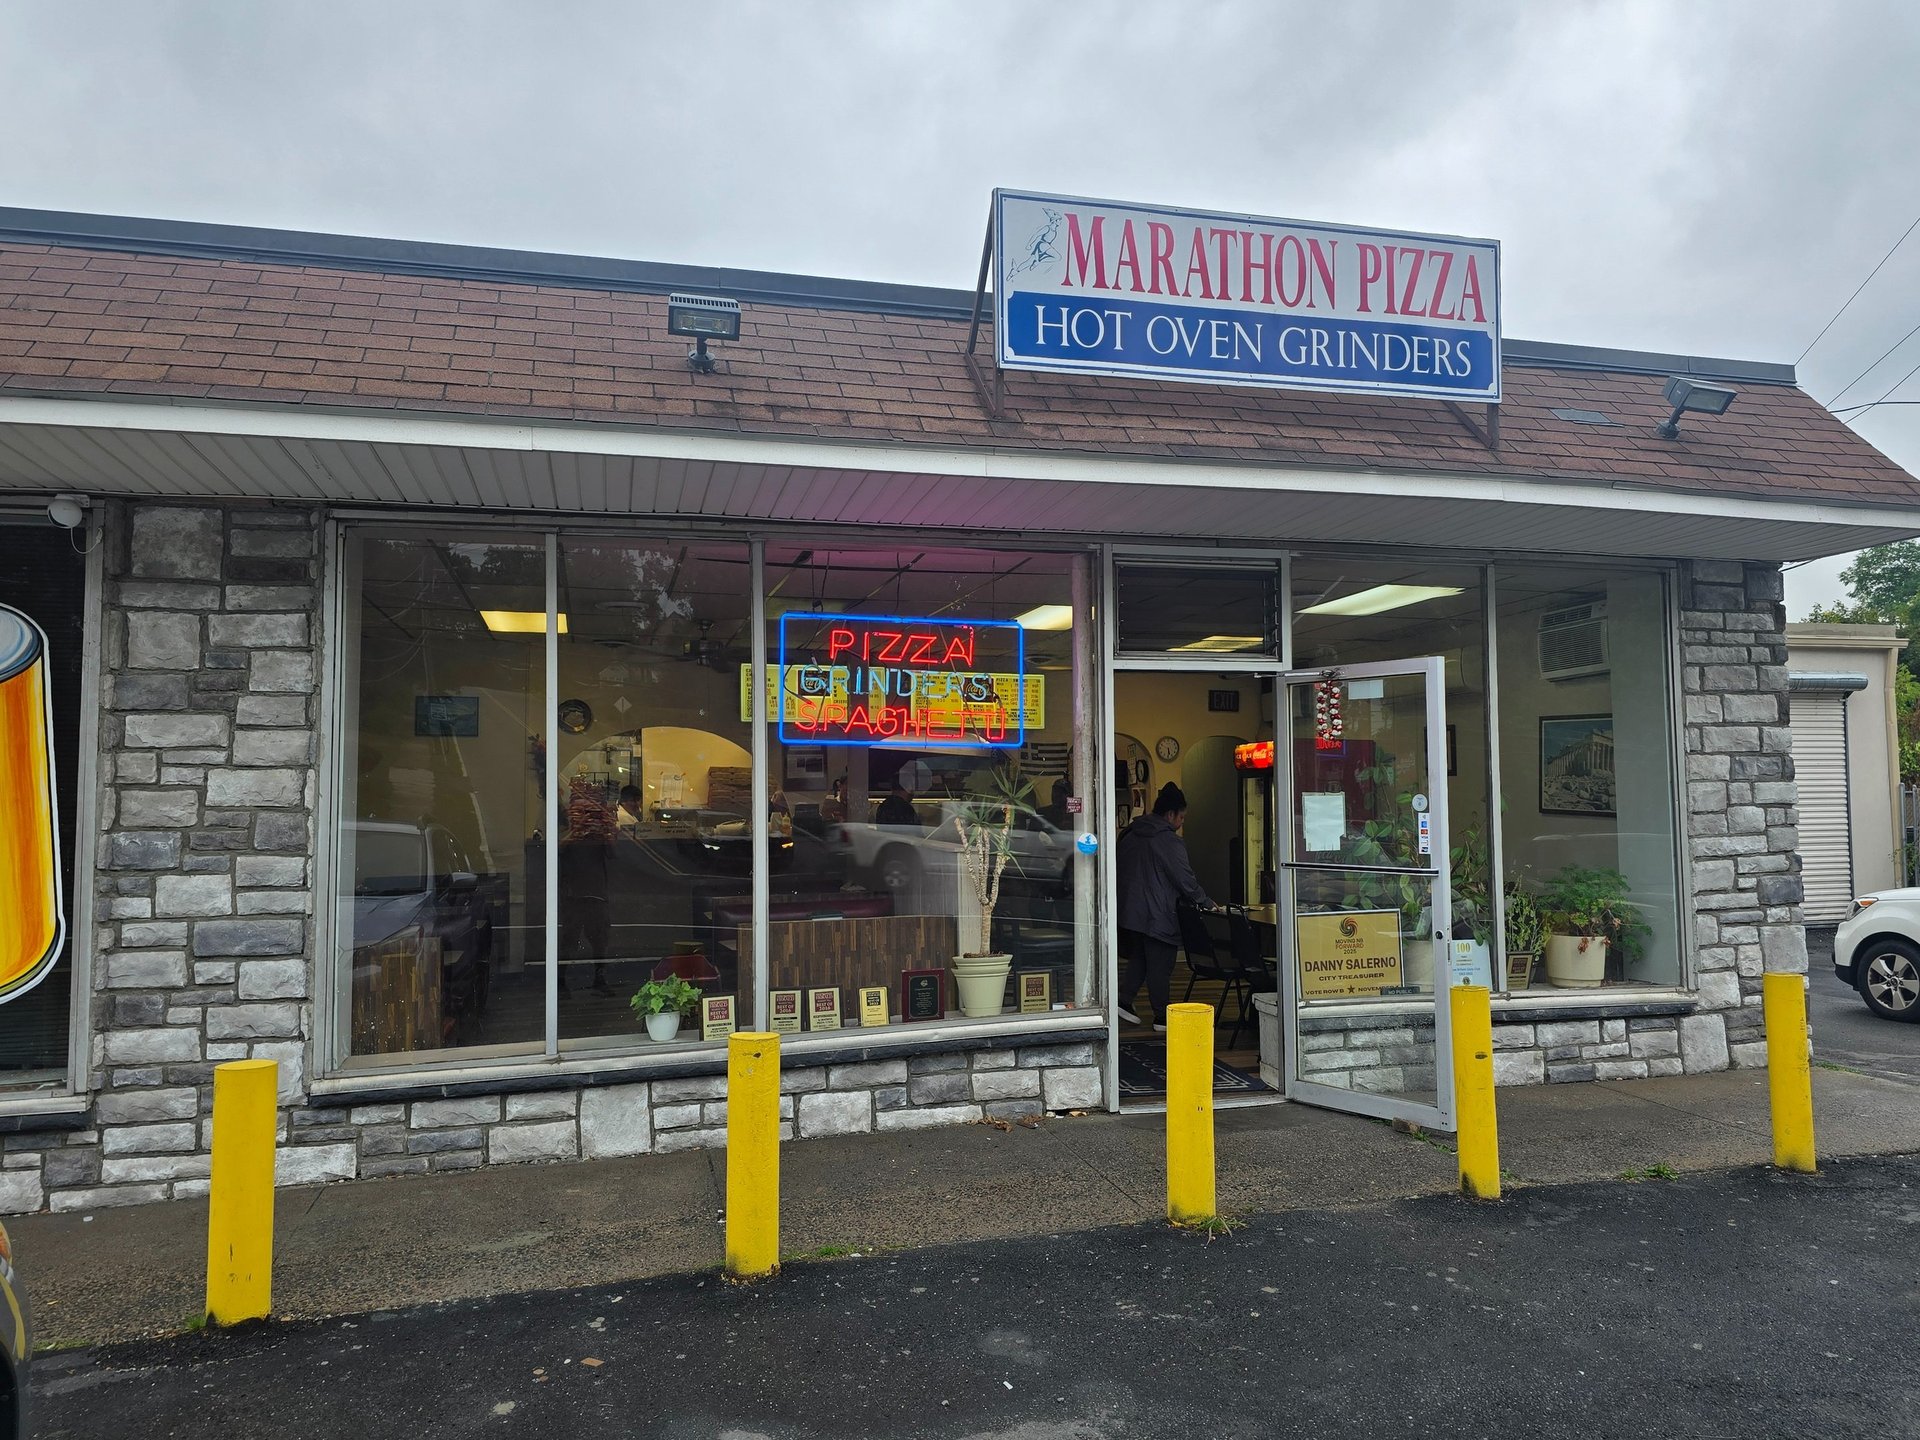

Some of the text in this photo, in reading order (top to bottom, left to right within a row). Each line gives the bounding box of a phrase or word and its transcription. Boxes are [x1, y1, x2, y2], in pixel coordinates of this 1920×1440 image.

[1061, 213, 1488, 323] MARATHON PIZZA
[1035, 304, 1472, 378] HOT OVEN GRINDERS
[829, 628, 975, 667] PIZZA
[800, 664, 993, 701] GRINDERS
[1213, 692, 1234, 710] EXIT
[1456, 942, 1471, 953] 100
[1305, 957, 1396, 972] DANNY SALERNO
[1338, 972, 1384, 980] TREASURER
